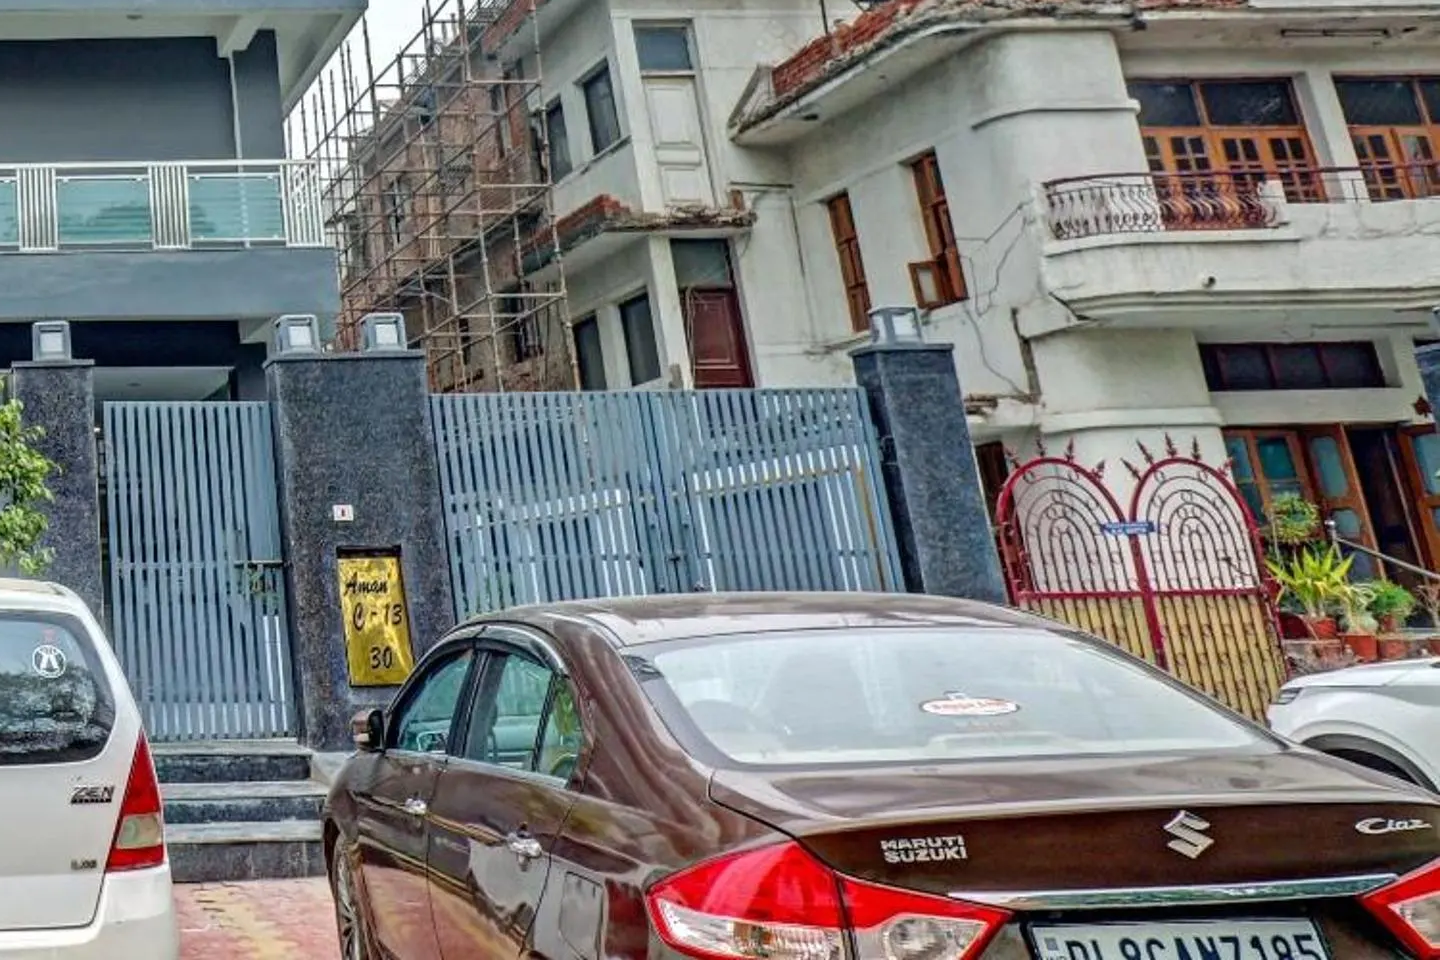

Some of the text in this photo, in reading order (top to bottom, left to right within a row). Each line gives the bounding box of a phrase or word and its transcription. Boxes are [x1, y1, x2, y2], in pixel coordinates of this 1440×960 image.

[370, 645, 393, 669] 30
[880, 835, 965, 850] MARUTI
[883, 846, 968, 864] SUZUKI
